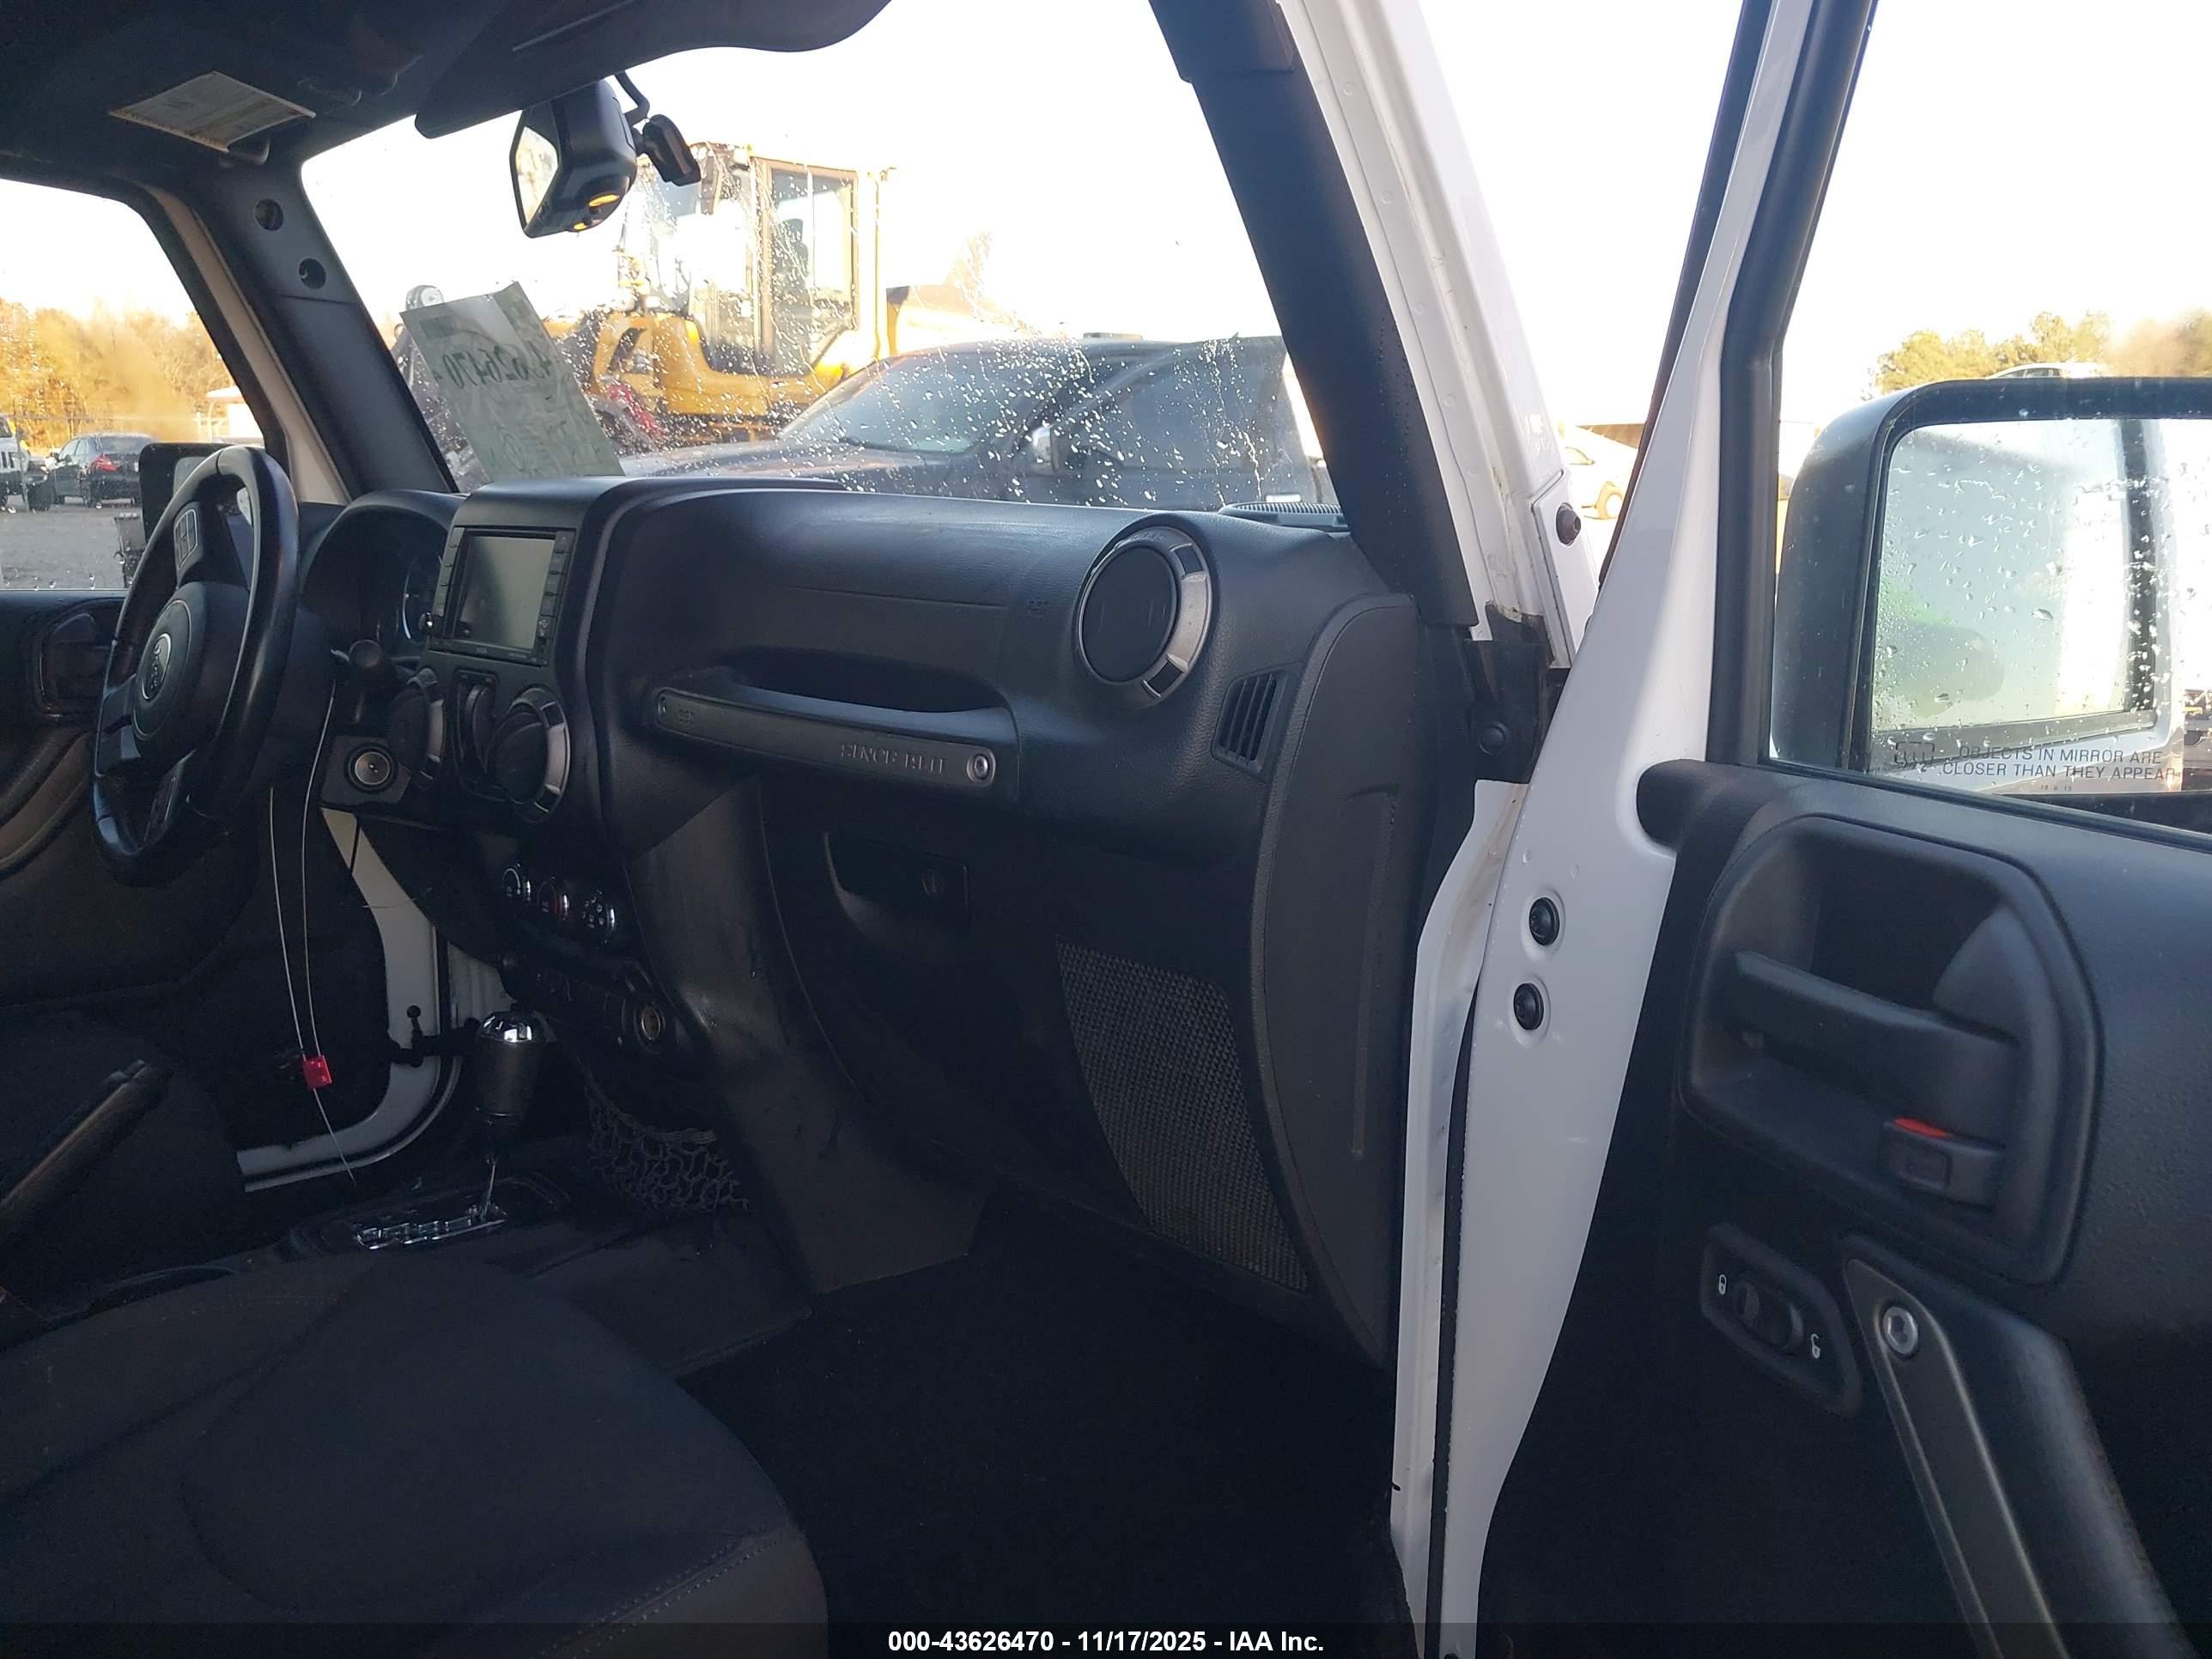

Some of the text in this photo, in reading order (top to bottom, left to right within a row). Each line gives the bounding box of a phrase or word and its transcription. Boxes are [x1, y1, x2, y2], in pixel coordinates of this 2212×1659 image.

[1959, 746, 2163, 764] OBJECTS IN MIRROR ARE
[1942, 761, 2176, 781] CLOSER THAN THEY APPEAR
